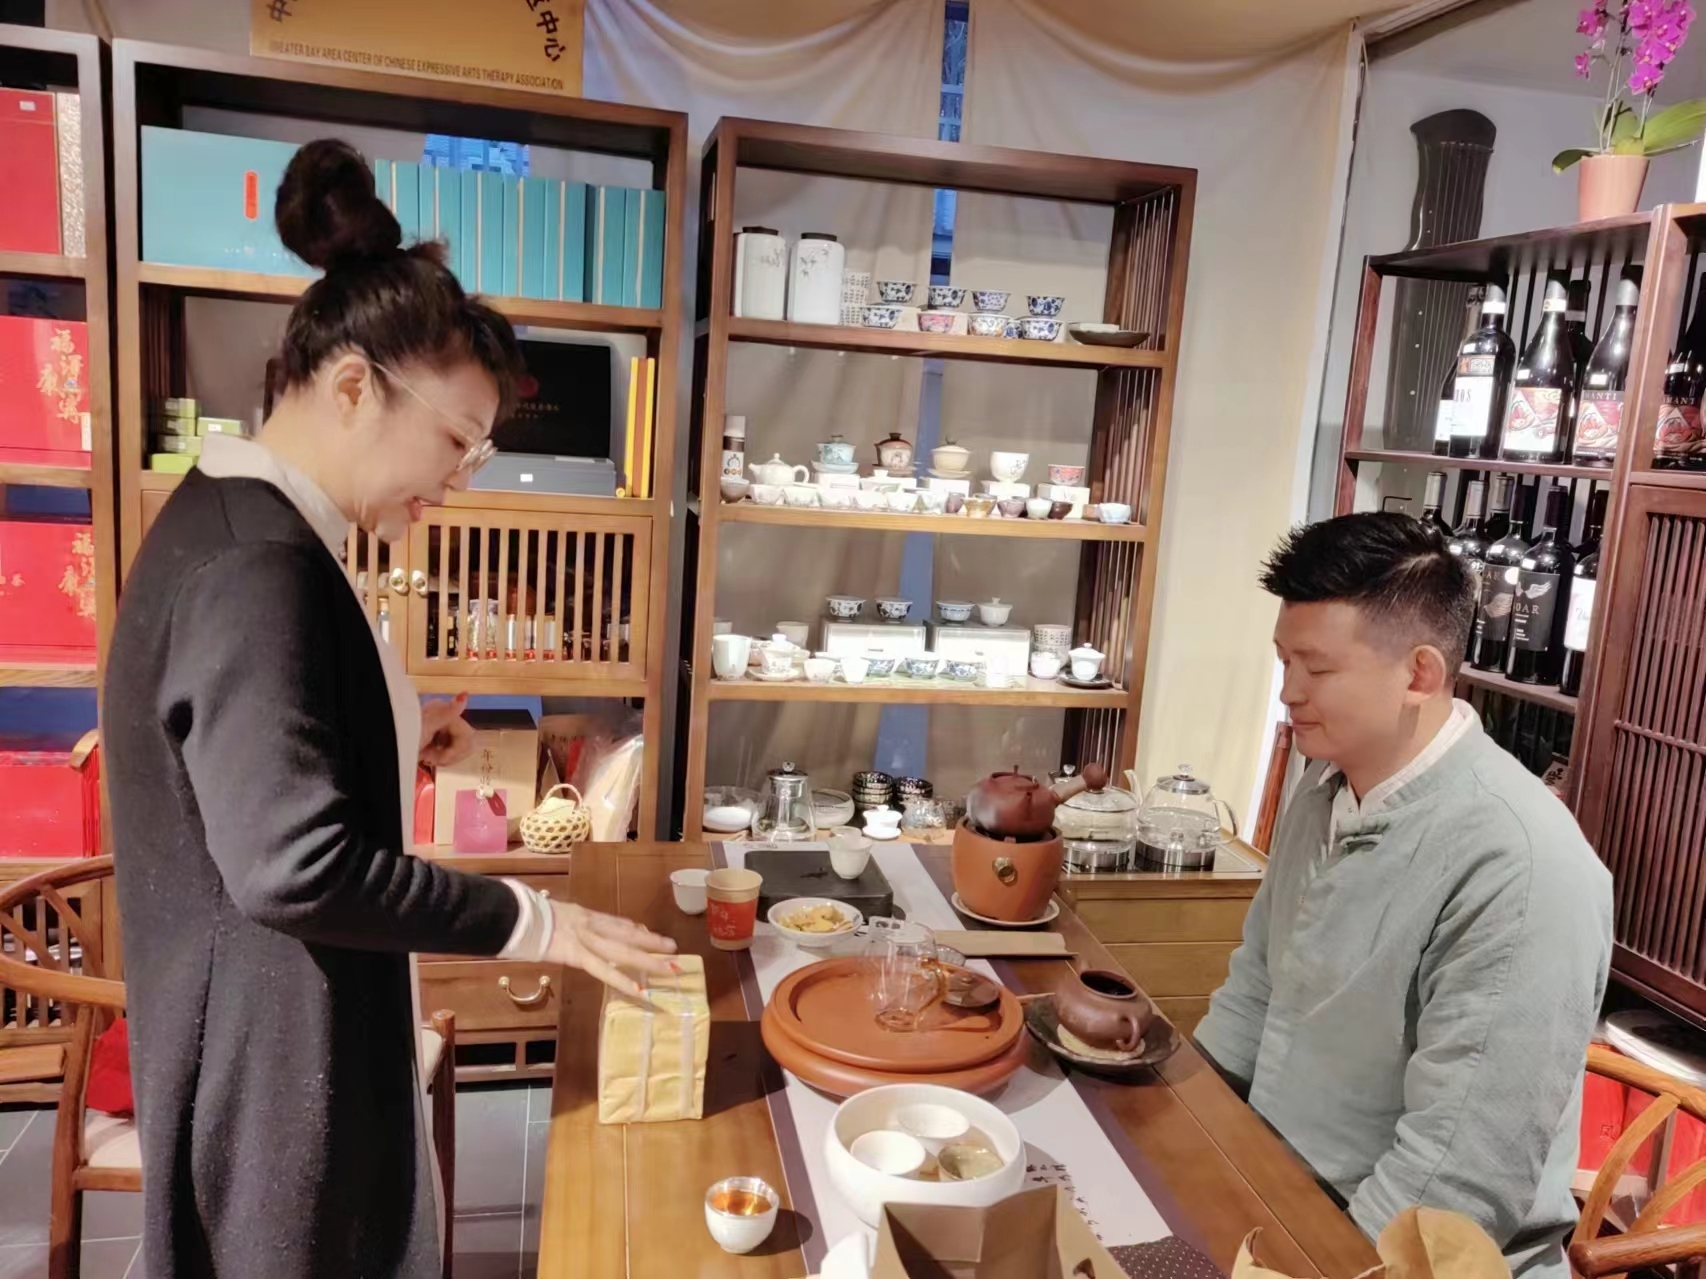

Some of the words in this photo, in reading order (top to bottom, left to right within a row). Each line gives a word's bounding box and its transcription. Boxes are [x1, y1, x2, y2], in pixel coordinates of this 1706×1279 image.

[305, 44, 321, 58] BAY
[321, 47, 343, 61] AREA
[343, 49, 372, 65] CENTER
[373, 53, 383, 67] OF
[384, 55, 415, 71] CHINESE
[417, 59, 461, 78] EXPRESSIVE
[462, 65, 481, 79] ARTS
[482, 68, 515, 83] THERAPY
[515, 73, 563, 90] ASSOCIATION
